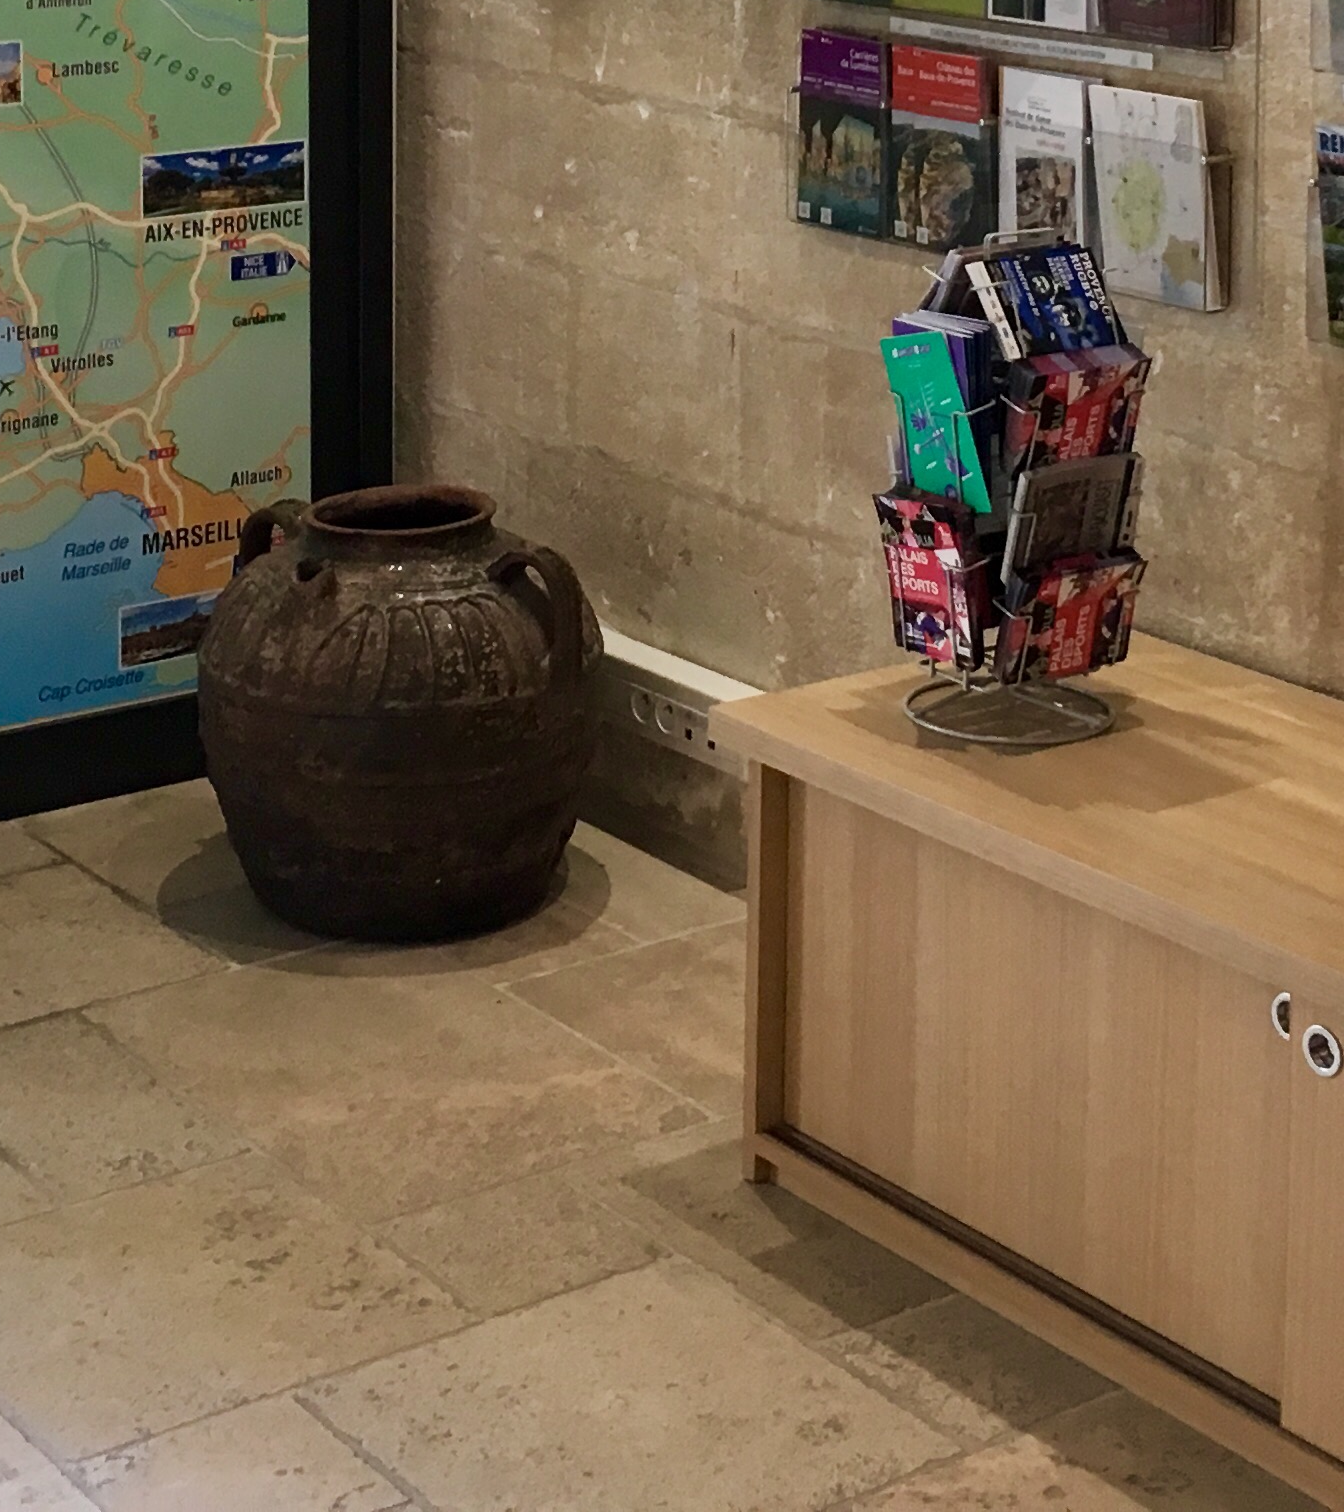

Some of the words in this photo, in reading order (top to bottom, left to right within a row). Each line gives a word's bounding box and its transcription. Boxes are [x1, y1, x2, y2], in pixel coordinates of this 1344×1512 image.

[74, 12, 234, 97] Trévaresse
[50, 58, 120, 79] Lambesc
[143, 207, 305, 244] AIX-EN-PROVENCE
[1068, 253, 1095, 299] RUGBY
[232, 310, 287, 328] Gardanne
[49, 350, 115, 375] Vitrolles
[230, 464, 283, 489] Allauch
[62, 541, 105, 560] Rade
[108, 535, 129, 552] de
[61, 555, 131, 582] Marseille
[893, 574, 939, 595] SPORTS
[1072, 603, 1091, 668] SPORTS
[37, 681, 71, 704] Cap
[73, 666, 144, 697] Croisette
